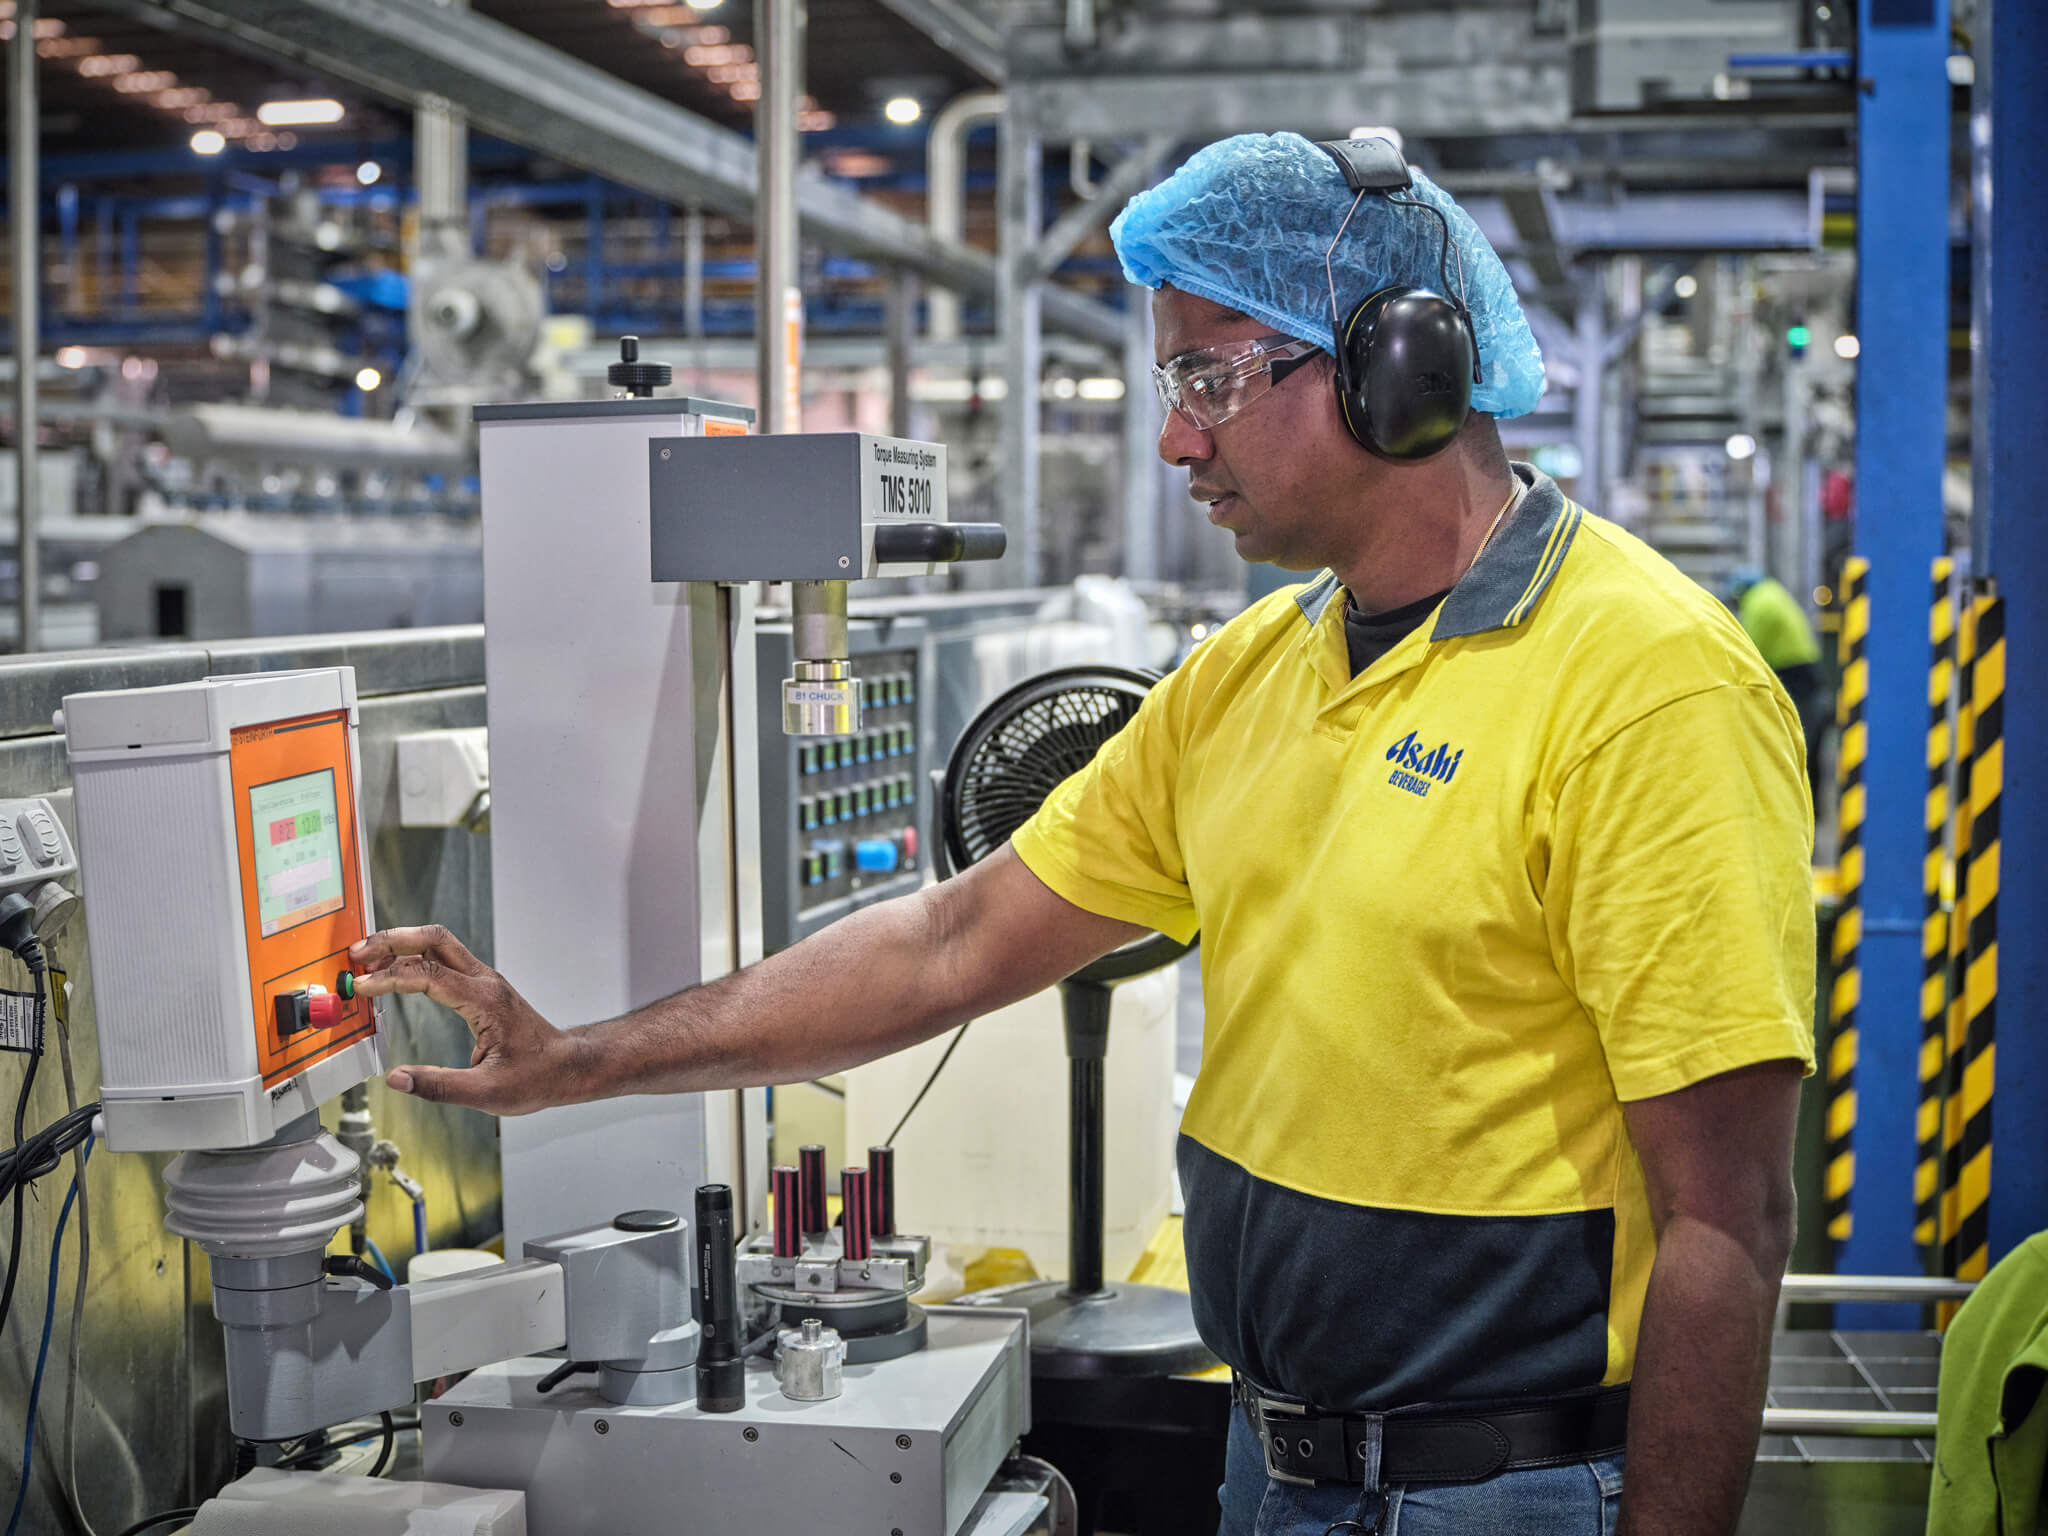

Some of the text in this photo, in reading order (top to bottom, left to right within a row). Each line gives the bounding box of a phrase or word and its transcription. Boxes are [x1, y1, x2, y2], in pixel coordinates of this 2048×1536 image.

[873, 443, 937, 471] Torque Measuring System
[880, 474, 932, 515] TMS 5010
[808, 691, 844, 702] CHUCK
[1385, 730, 1464, 784] Asahi
[1388, 769, 1431, 797] BEVERAGES
